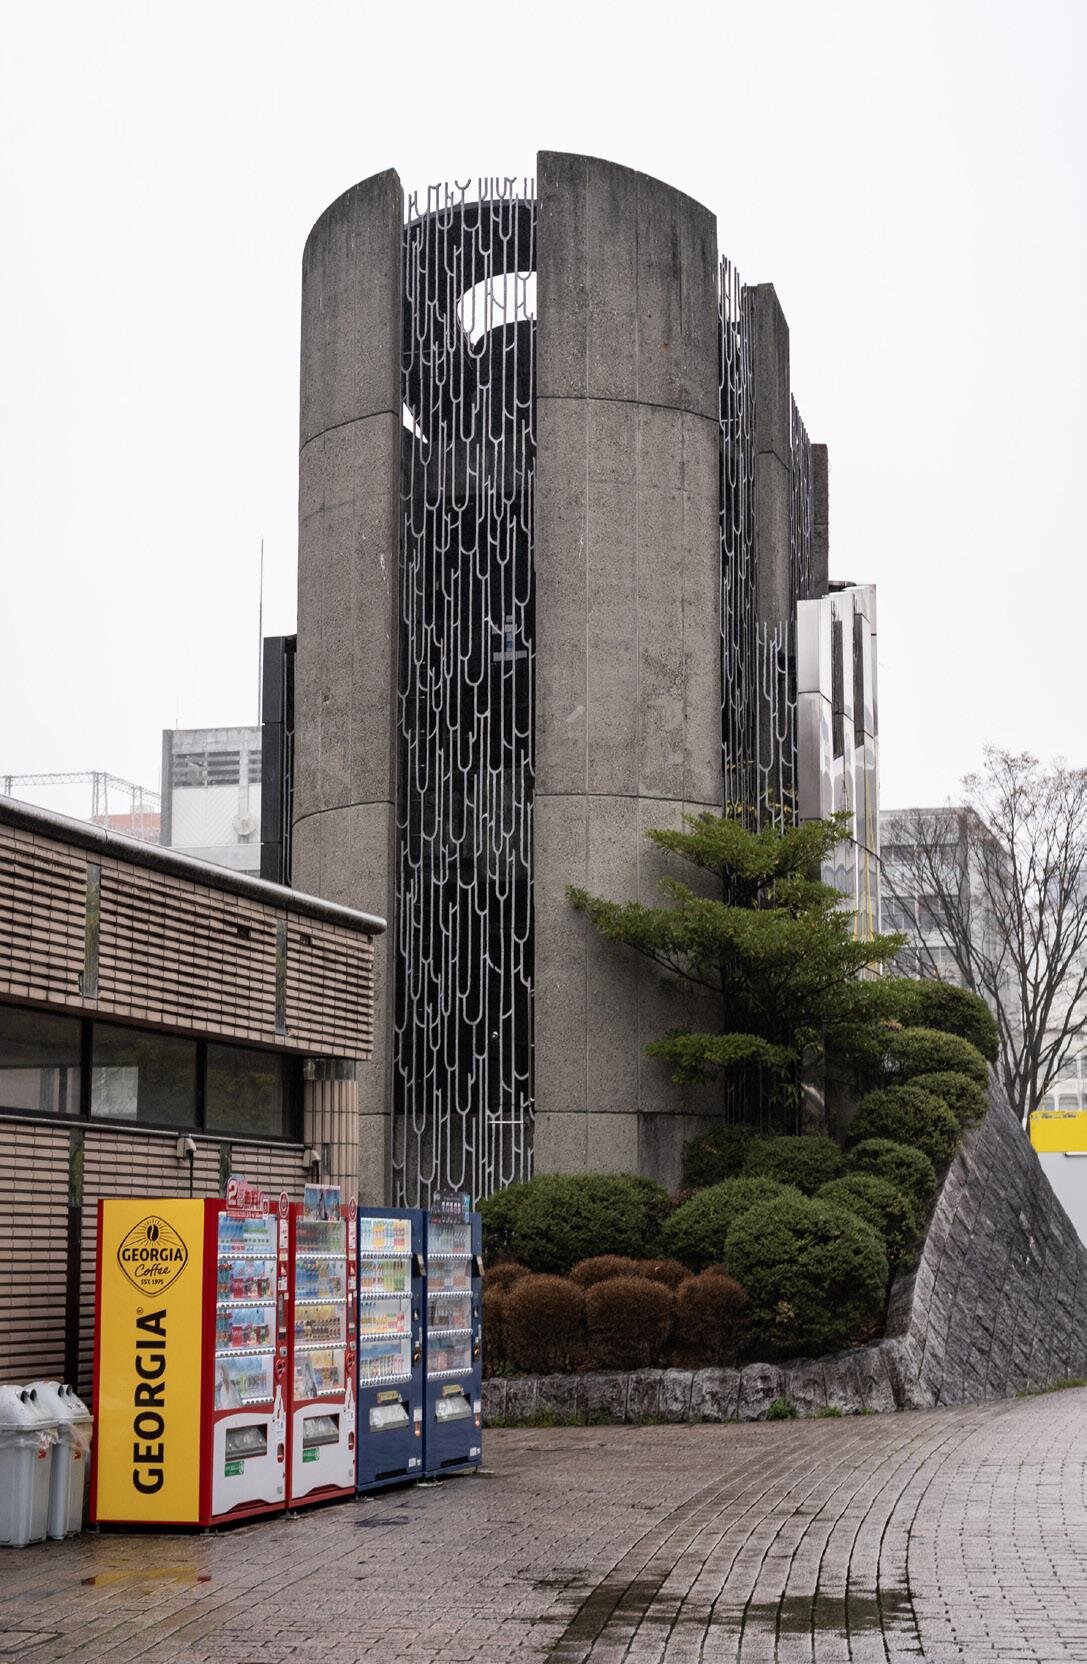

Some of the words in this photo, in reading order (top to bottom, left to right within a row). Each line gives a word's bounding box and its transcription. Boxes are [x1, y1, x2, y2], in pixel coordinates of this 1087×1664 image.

[122, 1248, 183, 1262] GEORGIA
[135, 1263, 171, 1278] Coffee
[132, 1309, 167, 1495] GEORGIA
